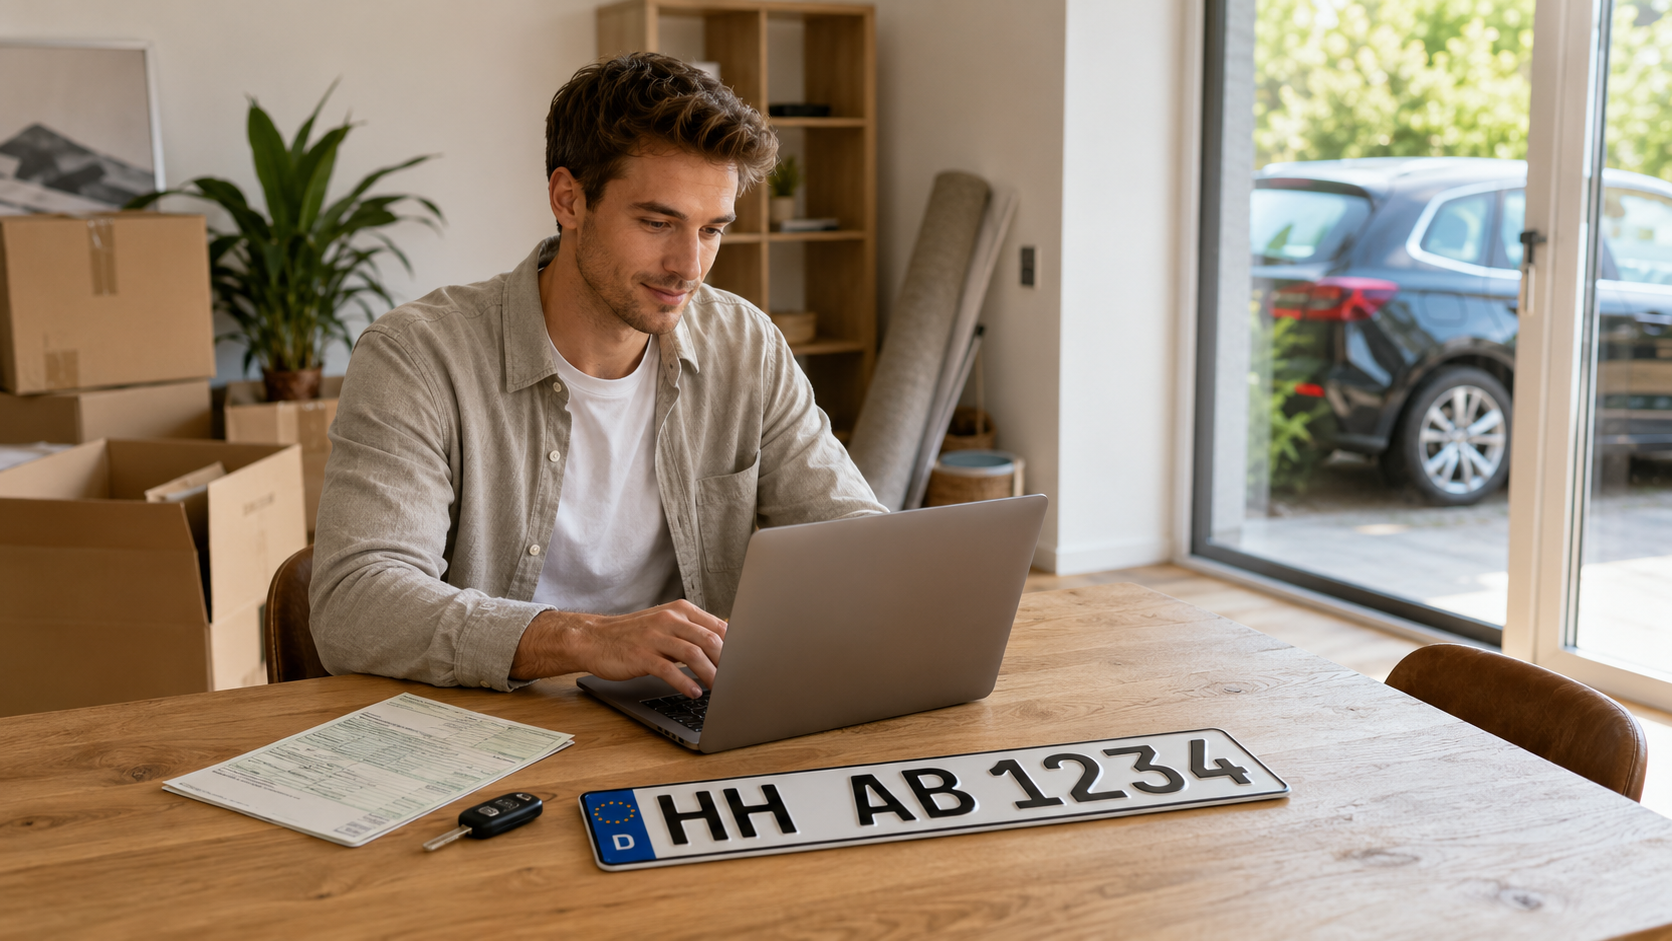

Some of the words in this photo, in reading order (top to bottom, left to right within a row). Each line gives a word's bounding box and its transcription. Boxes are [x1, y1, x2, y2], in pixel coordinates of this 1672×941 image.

[657, 784, 796, 846] HH
[851, 768, 976, 827] AB
[989, 740, 1250, 809] 1234
[612, 834, 635, 851] D
